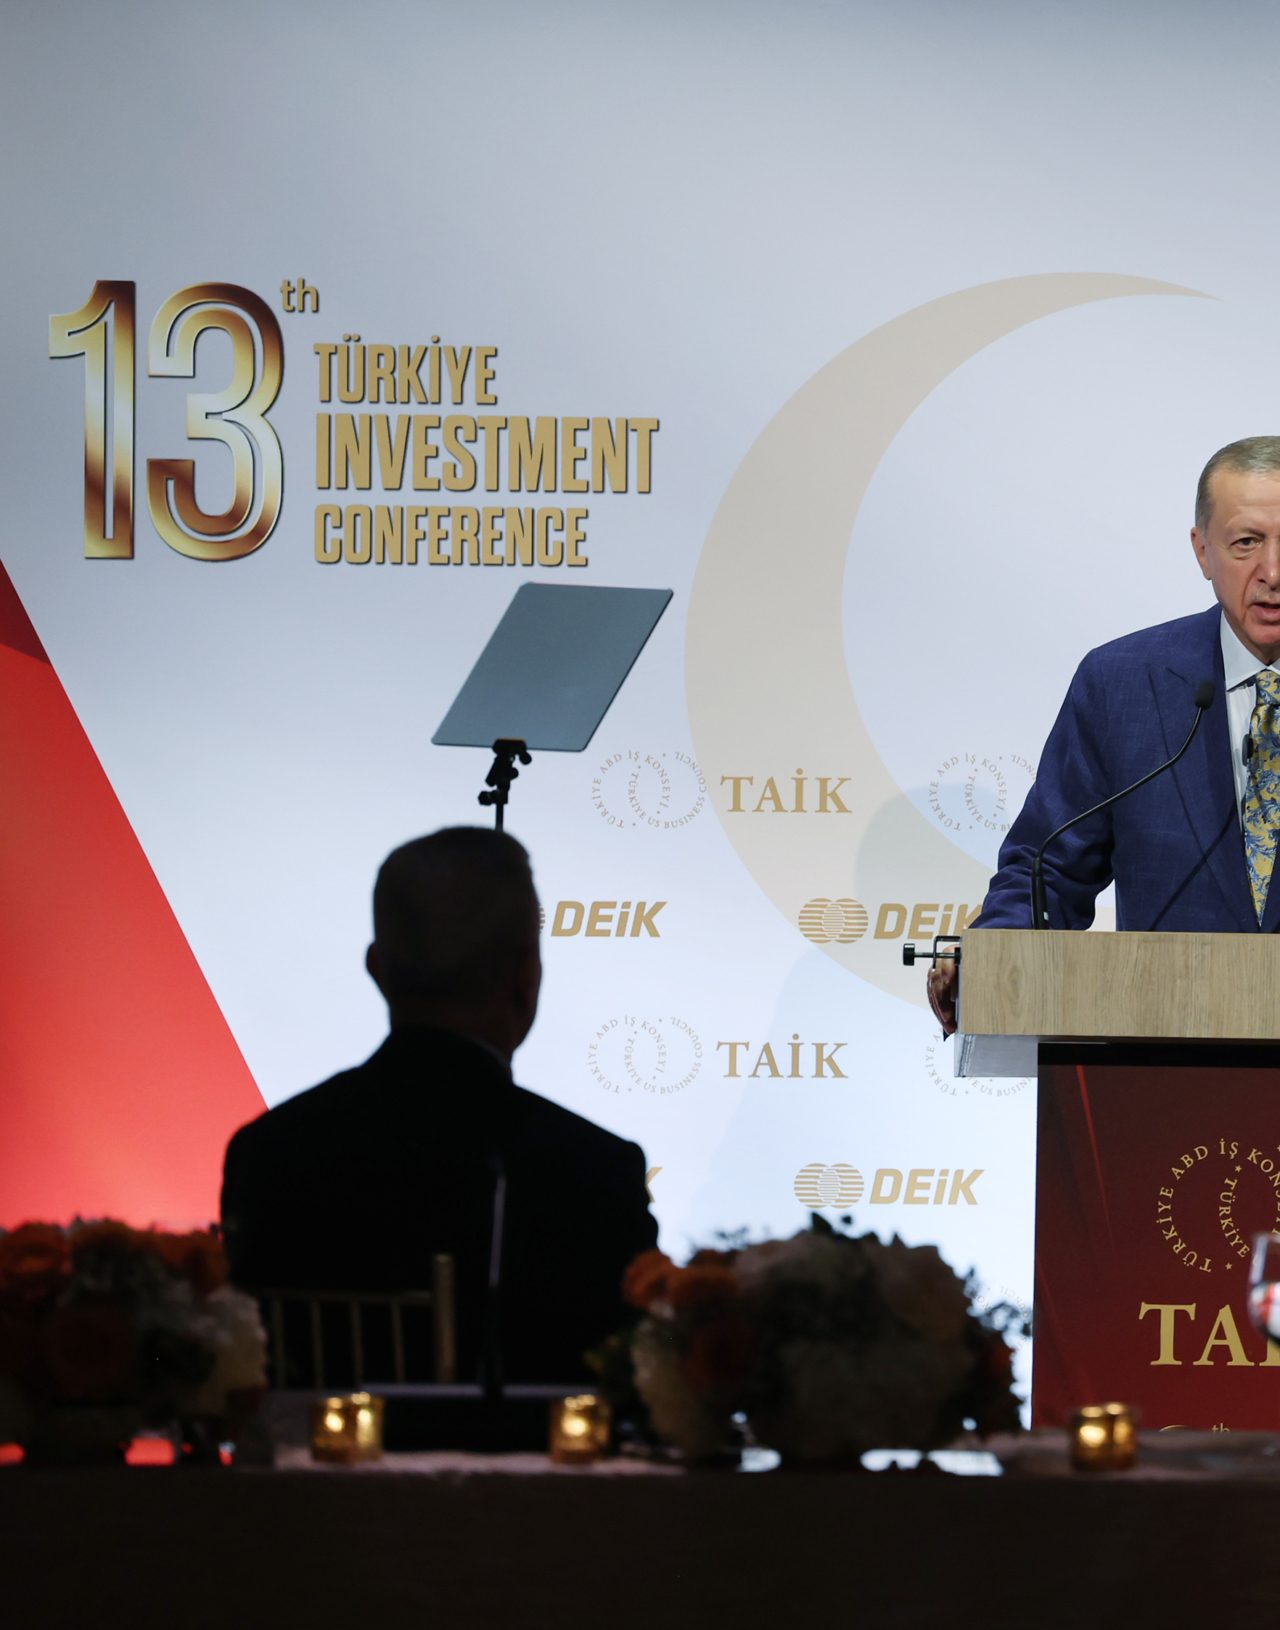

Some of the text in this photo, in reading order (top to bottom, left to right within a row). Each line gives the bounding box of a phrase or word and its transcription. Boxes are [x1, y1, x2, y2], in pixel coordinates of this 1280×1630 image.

[314, 333, 498, 405] TÜRKİYE
[316, 413, 660, 494] INVESTMENT
[314, 504, 588, 567] CONFERENCE
[720, 768, 852, 814] TAİK
[716, 1033, 849, 1079] TAİK
[1171, 1146, 1208, 1180] ABD
[1220, 1138, 1239, 1159] İŞ
[1156, 1187, 1213, 1273] TÜRKİYE
[1219, 1178, 1250, 1258] TÜRKİYE
